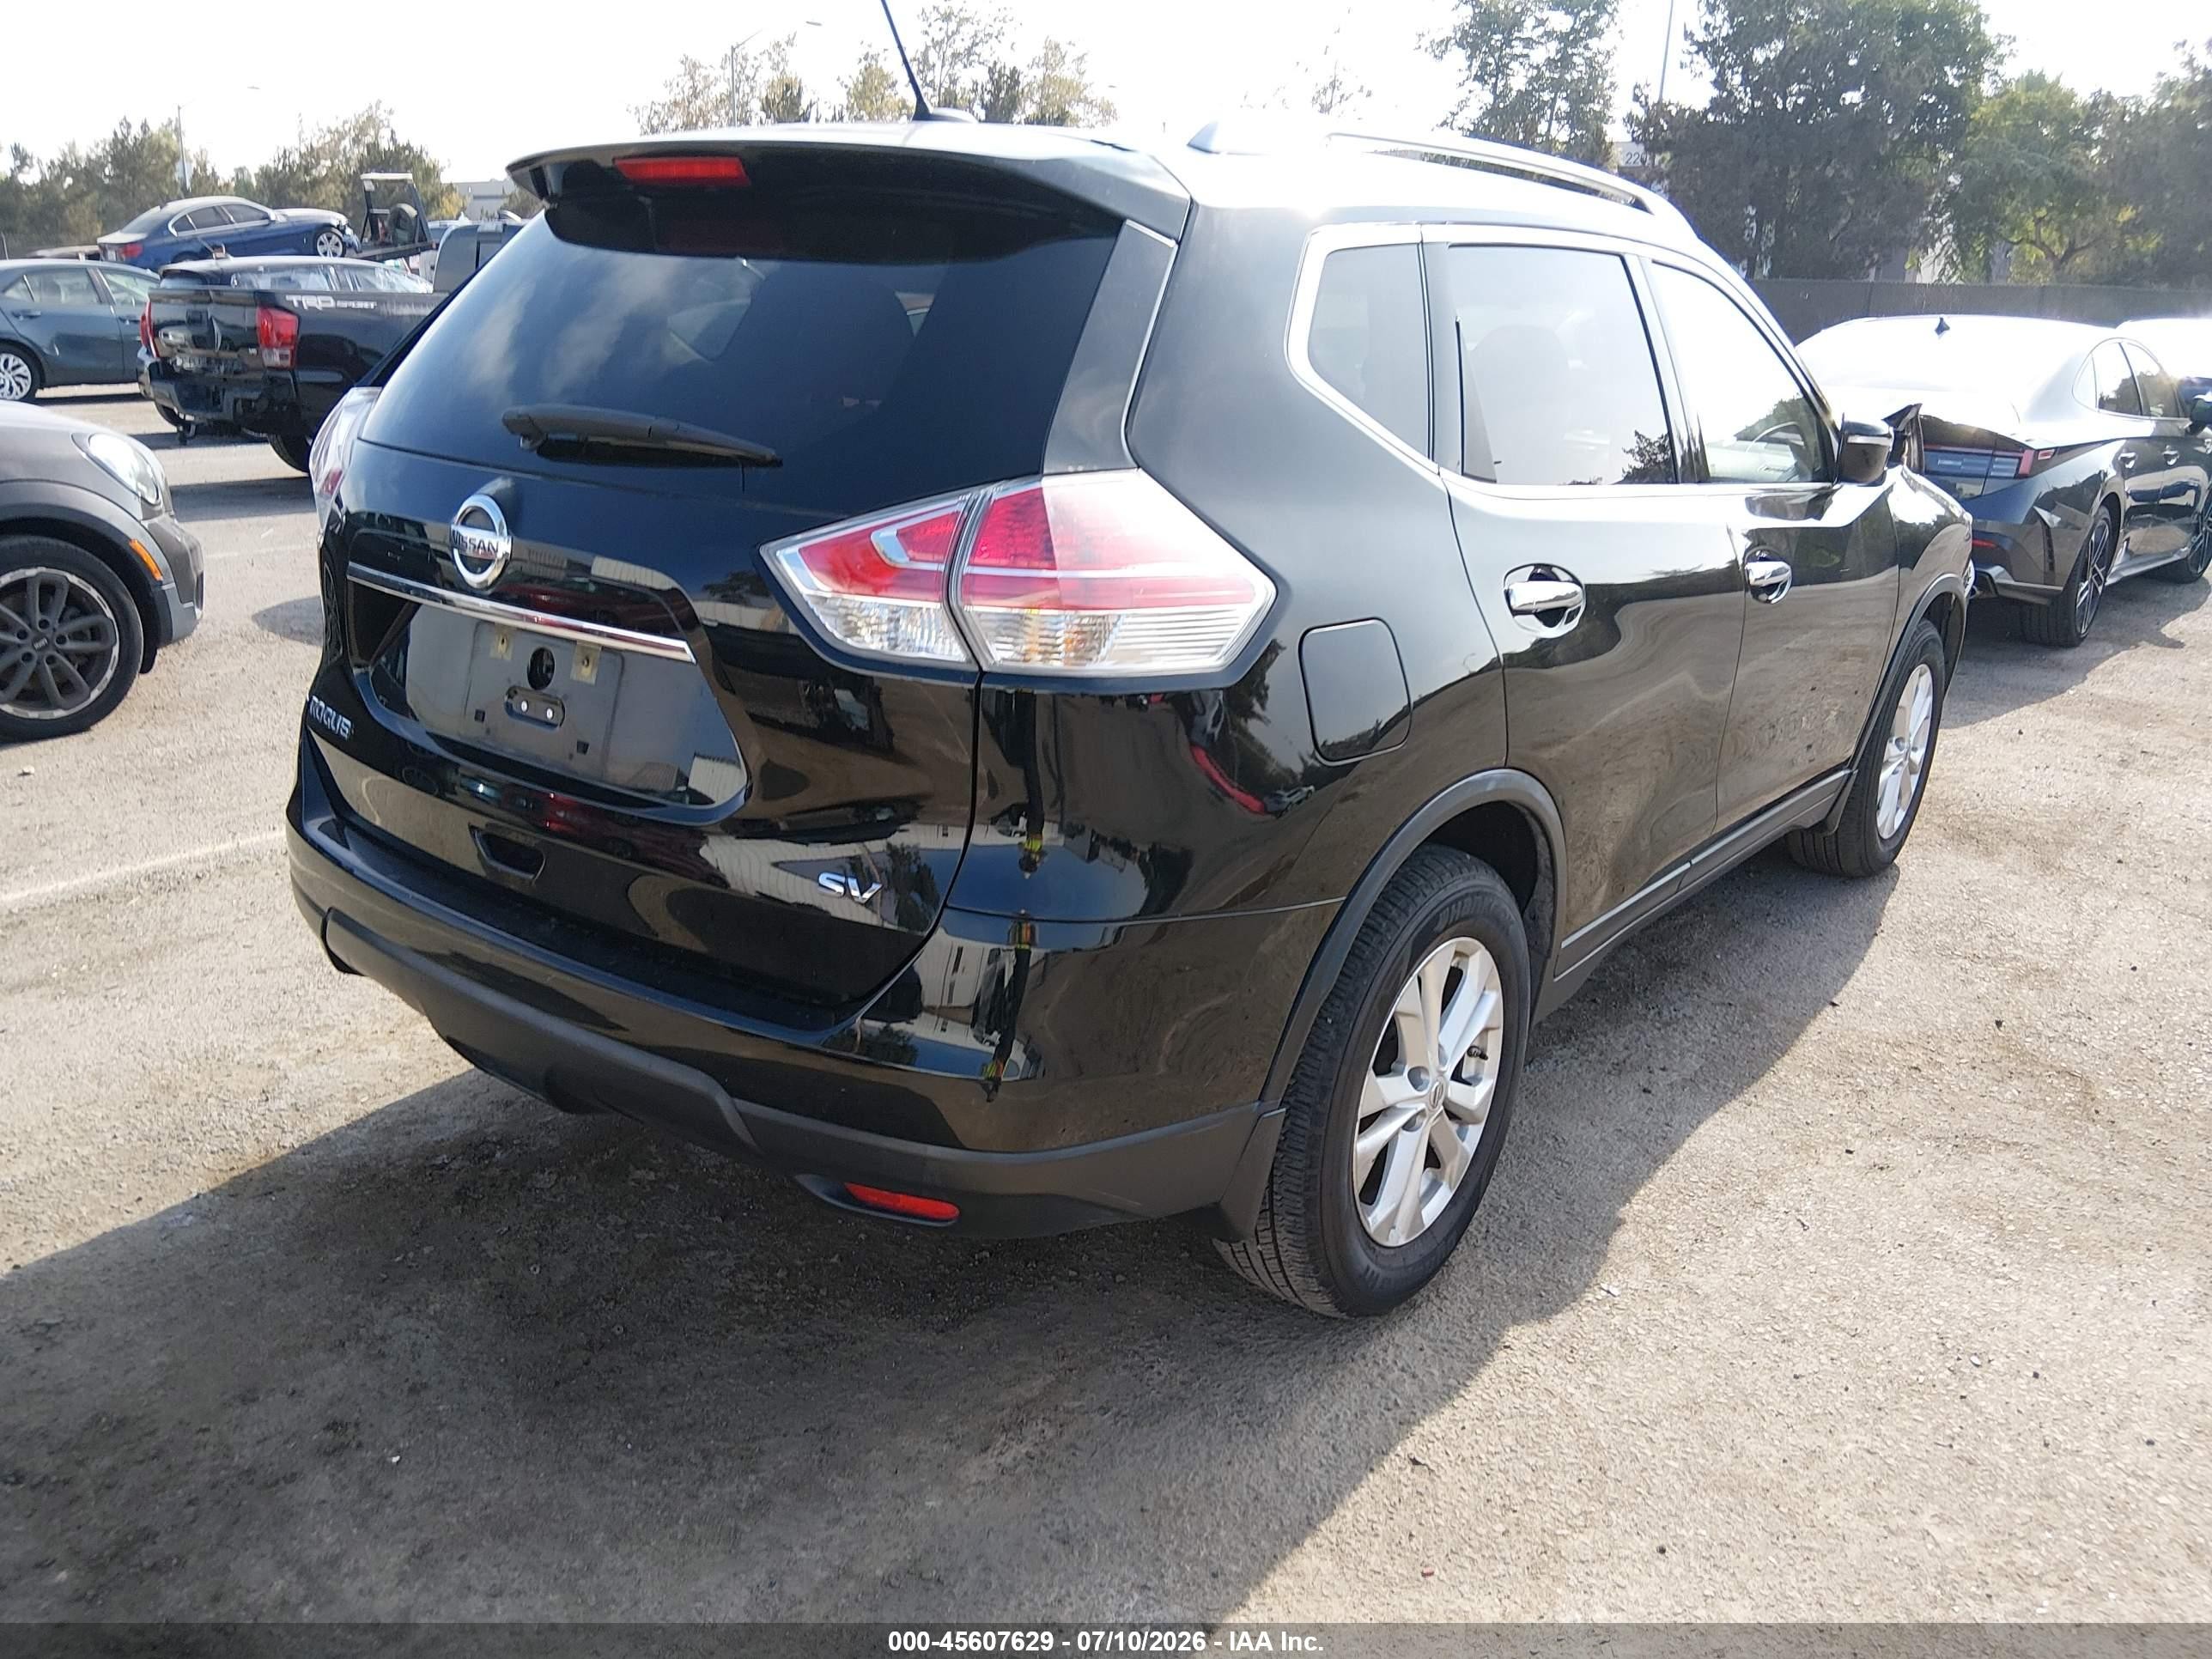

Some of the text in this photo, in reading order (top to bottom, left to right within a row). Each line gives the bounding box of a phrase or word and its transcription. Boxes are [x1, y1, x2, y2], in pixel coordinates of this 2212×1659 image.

[285, 295, 336, 310] TRD
[451, 528, 499, 554] NISSAN
[818, 872, 883, 903] SV
